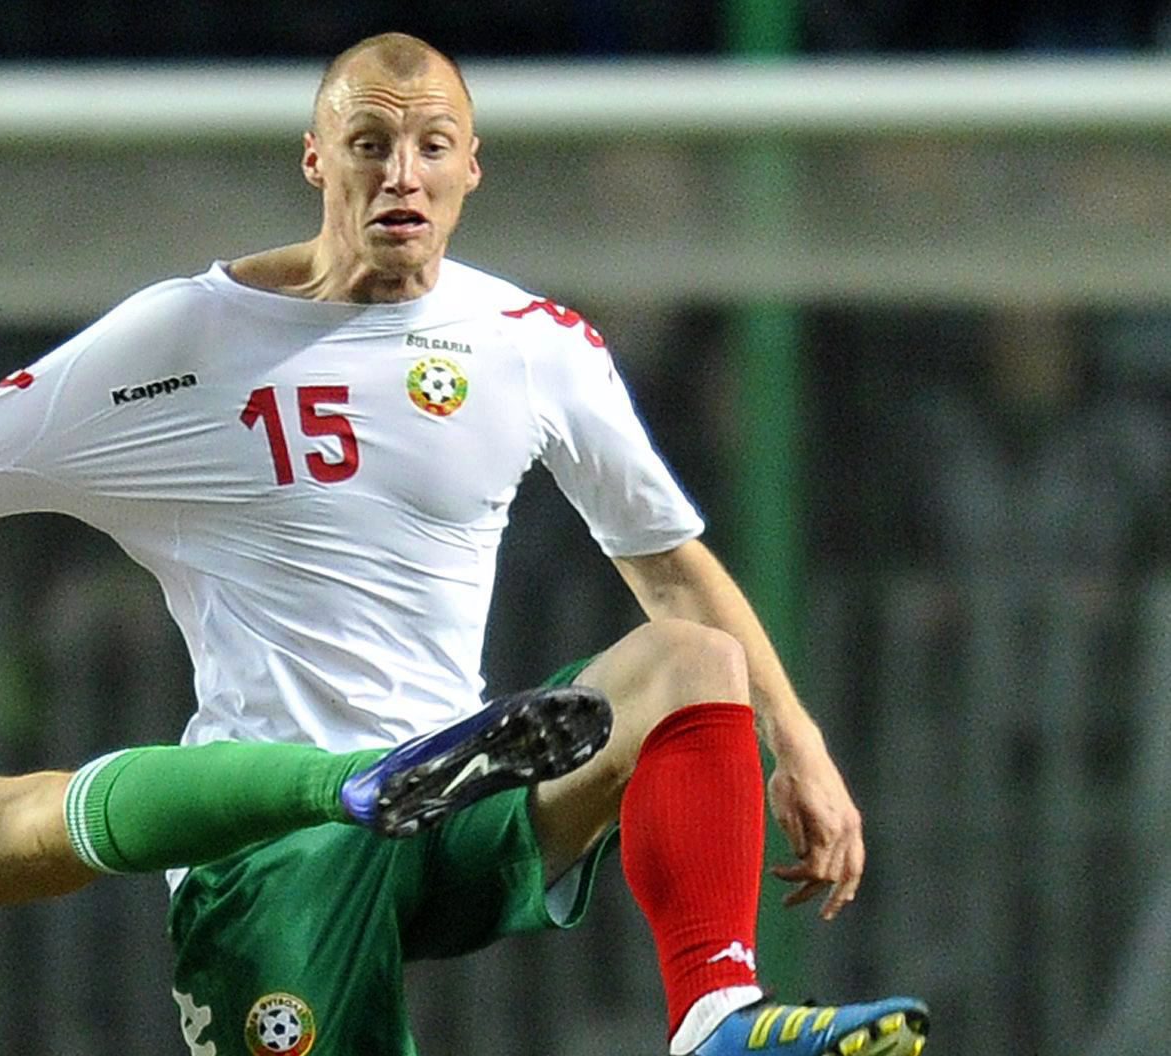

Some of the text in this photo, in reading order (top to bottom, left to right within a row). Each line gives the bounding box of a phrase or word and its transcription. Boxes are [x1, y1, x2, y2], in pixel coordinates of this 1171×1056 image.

[406, 333, 472, 354] BULGARIA
[111, 373, 198, 405] Kappa
[239, 385, 360, 485] 15
